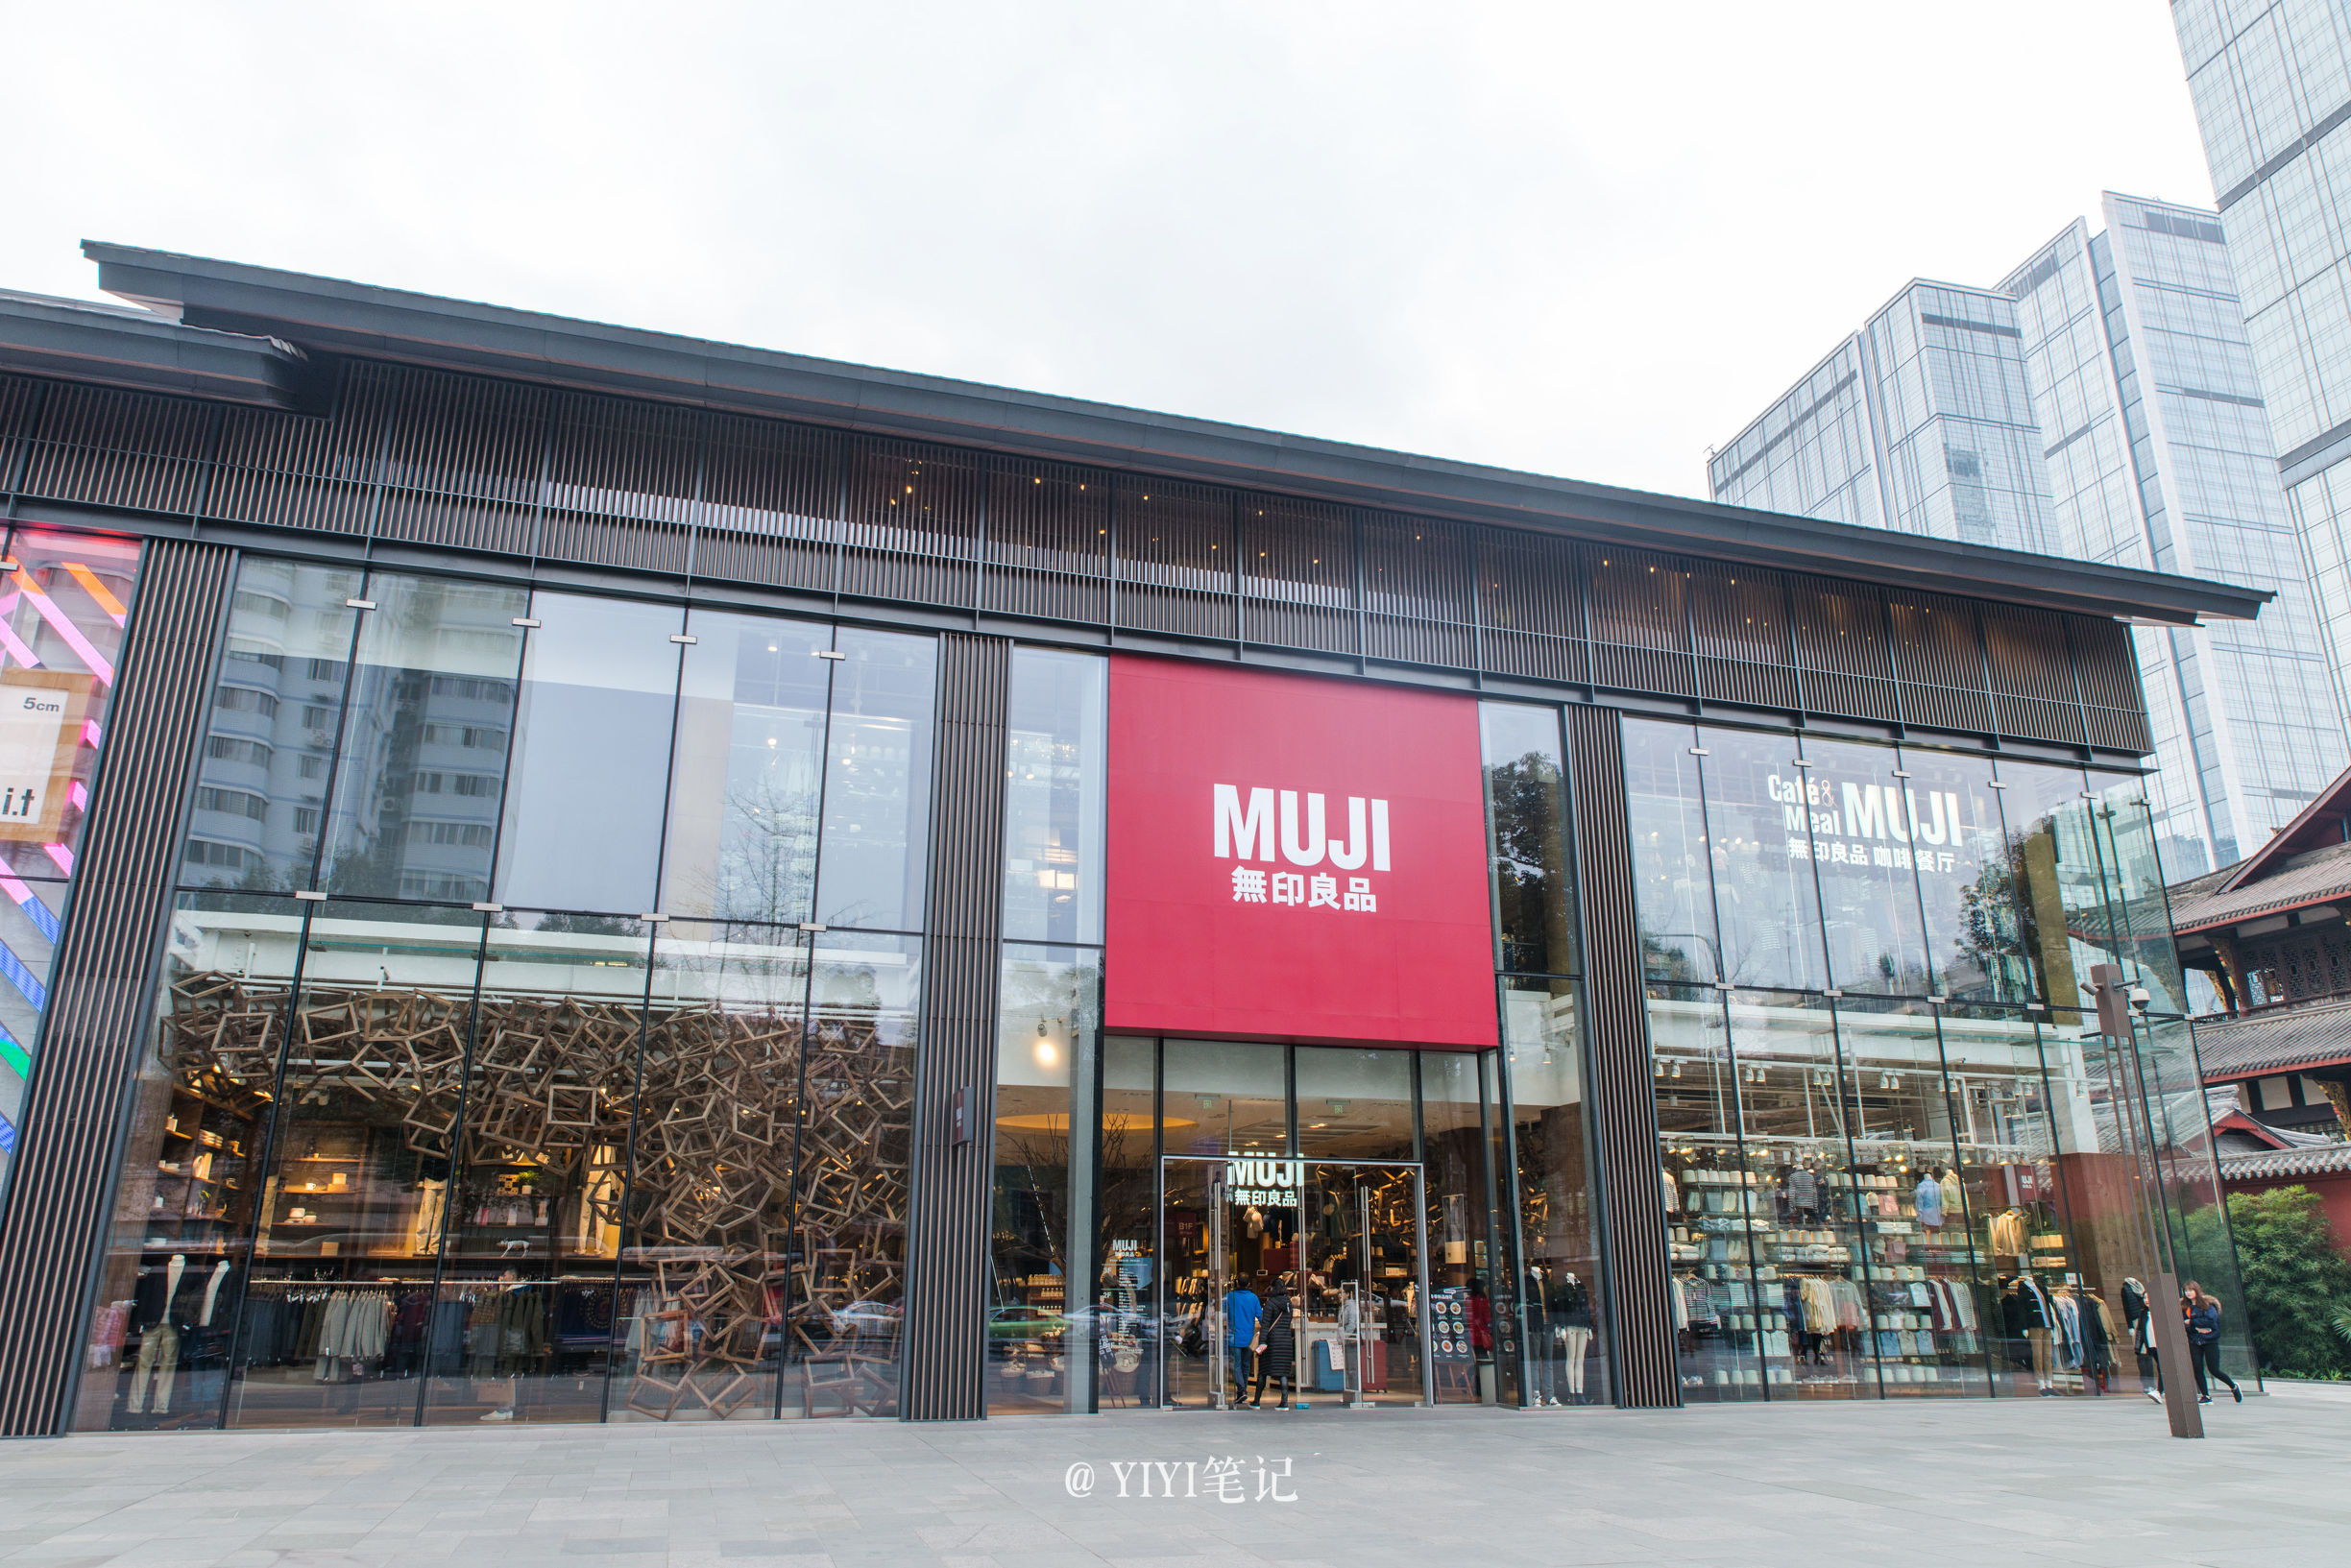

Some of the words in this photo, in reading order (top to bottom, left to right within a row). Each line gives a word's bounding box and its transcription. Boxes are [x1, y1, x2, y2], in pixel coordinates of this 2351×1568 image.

[23, 697, 60, 712] 5cm
[2, 787, 35, 816] i.t
[1767, 774, 1820, 806] Café
[1821, 779, 1837, 808] &
[1214, 784, 1391, 872] MUJI
[1785, 805, 1841, 835] Meal
[1841, 782, 1963, 847] MUJI
[1788, 836, 1869, 866] 無印良品
[1231, 865, 1376, 912] 無印良品
[1227, 1151, 1304, 1187] MUJI
[1235, 1190, 1297, 1207] 無印良品
[1112, 1239, 1137, 1251] MUJI
